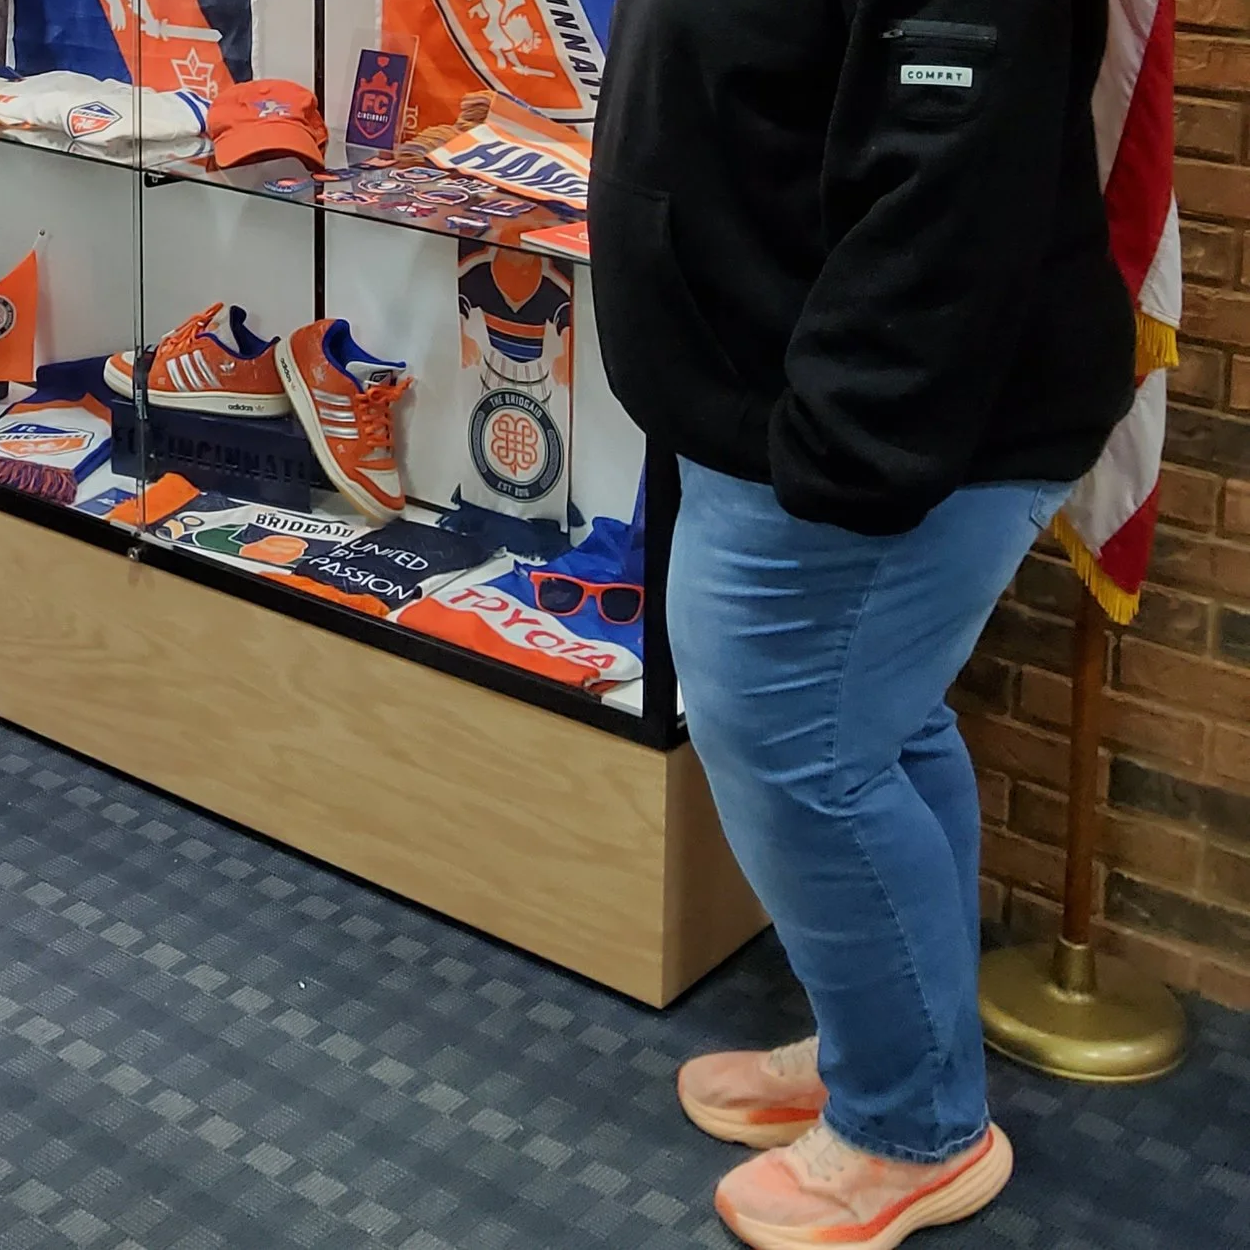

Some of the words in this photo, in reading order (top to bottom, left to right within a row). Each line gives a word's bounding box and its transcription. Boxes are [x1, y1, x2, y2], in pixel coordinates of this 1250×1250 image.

[907, 70, 963, 81] COMFRT
[362, 93, 389, 114] FC
[228, 403, 253, 412] adidas
[490, 393, 503, 408] THE
[319, 548, 365, 560] BY
[350, 540, 418, 571] UNITED
[309, 556, 413, 600] PASSION
[448, 588, 617, 669] TOYOTA
